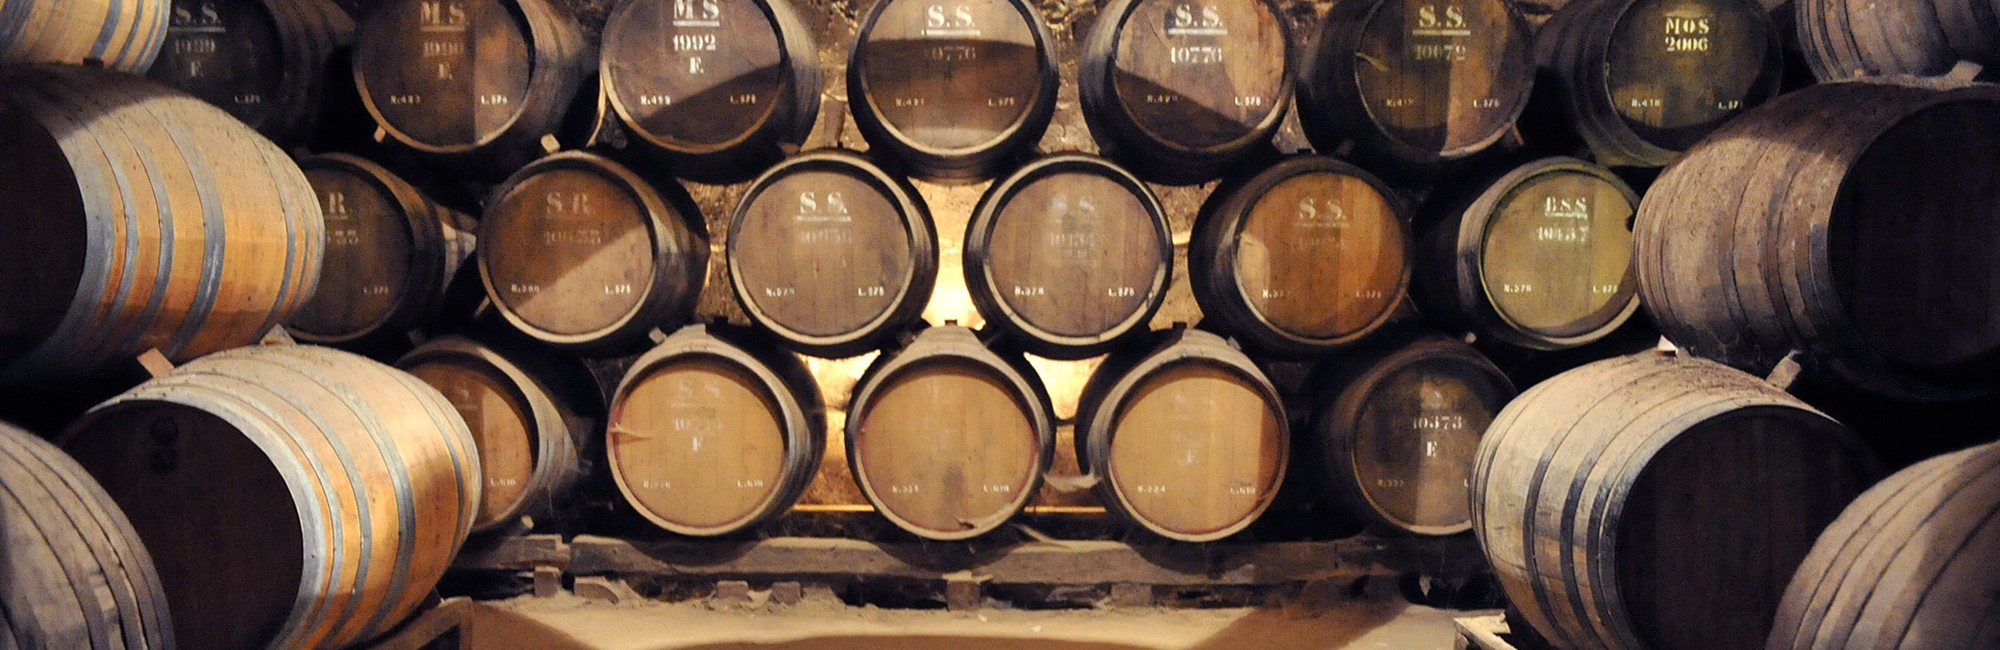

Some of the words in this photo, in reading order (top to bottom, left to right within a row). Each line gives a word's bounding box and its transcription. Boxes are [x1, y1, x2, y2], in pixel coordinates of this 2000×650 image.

[928, 5, 975, 27] S.S.
[1175, 5, 1223, 28] S.S.
[1419, 6, 1466, 28] S.S.
[1665, 18, 1710, 35] MOS
[673, 35, 716, 51] 1992
[1665, 38, 1709, 52] 2006
[1170, 47, 1222, 63] 10776
